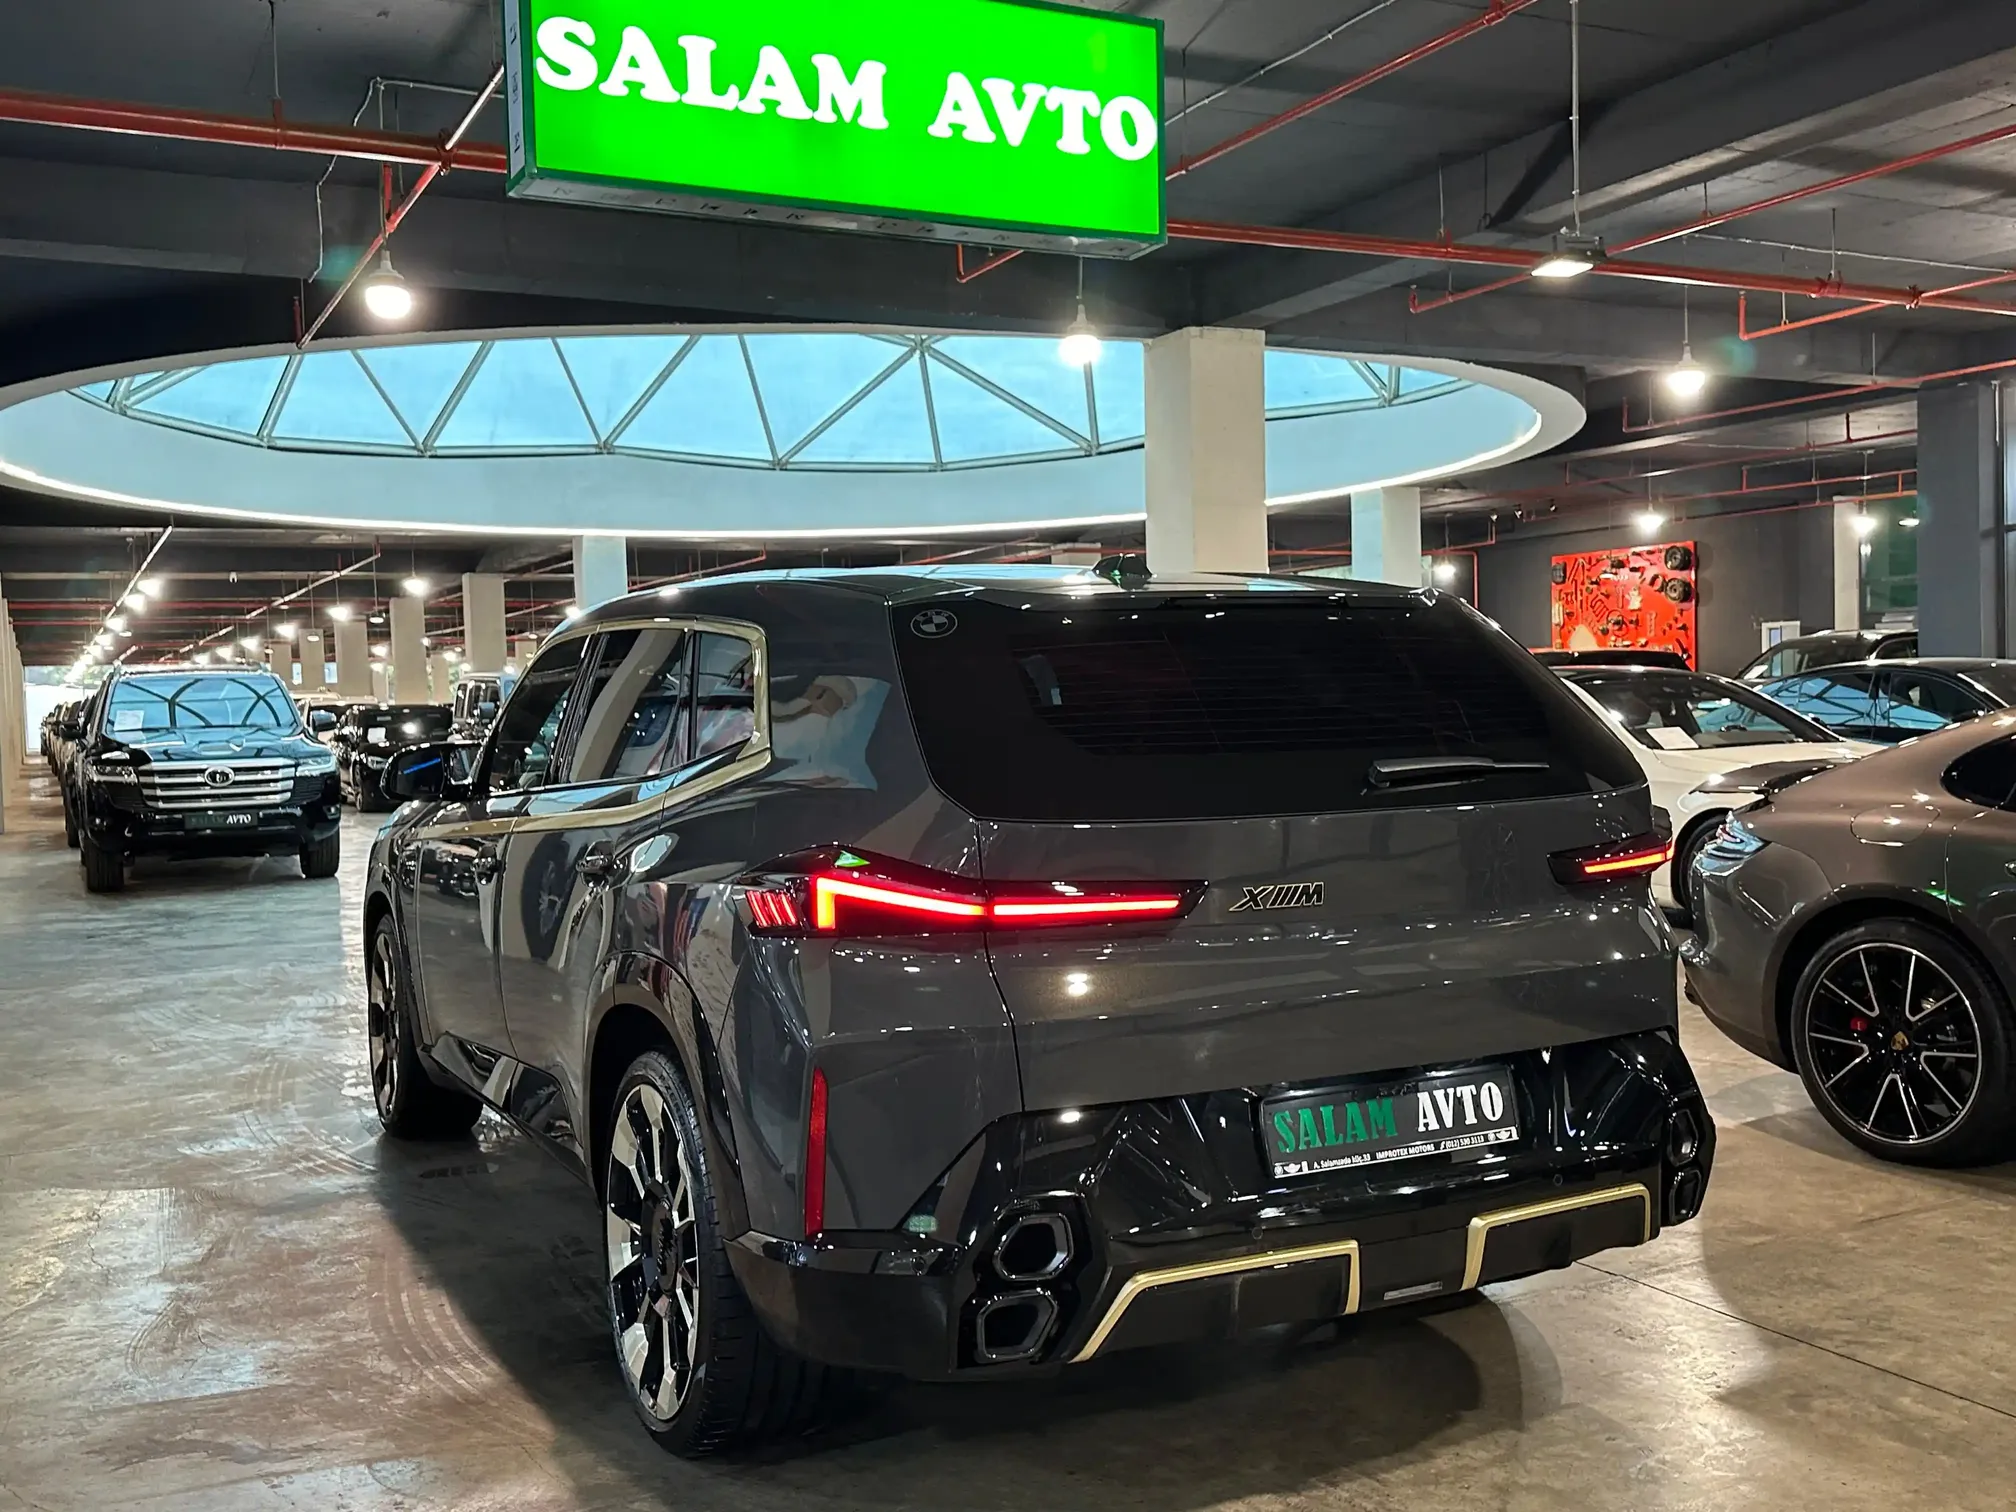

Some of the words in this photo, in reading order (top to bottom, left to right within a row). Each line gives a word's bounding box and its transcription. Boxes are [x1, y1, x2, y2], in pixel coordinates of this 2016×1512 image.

[535, 15, 889, 131] SALAM
[927, 71, 1158, 162] AVTO
[226, 813, 252, 825] AVTO
[1273, 1096, 1399, 1154] SALAM
[1417, 1081, 1505, 1133] AVTO
[1376, 1148, 1408, 1159] IMPROTEX
[1408, 1143, 1435, 1155] MOTORS
